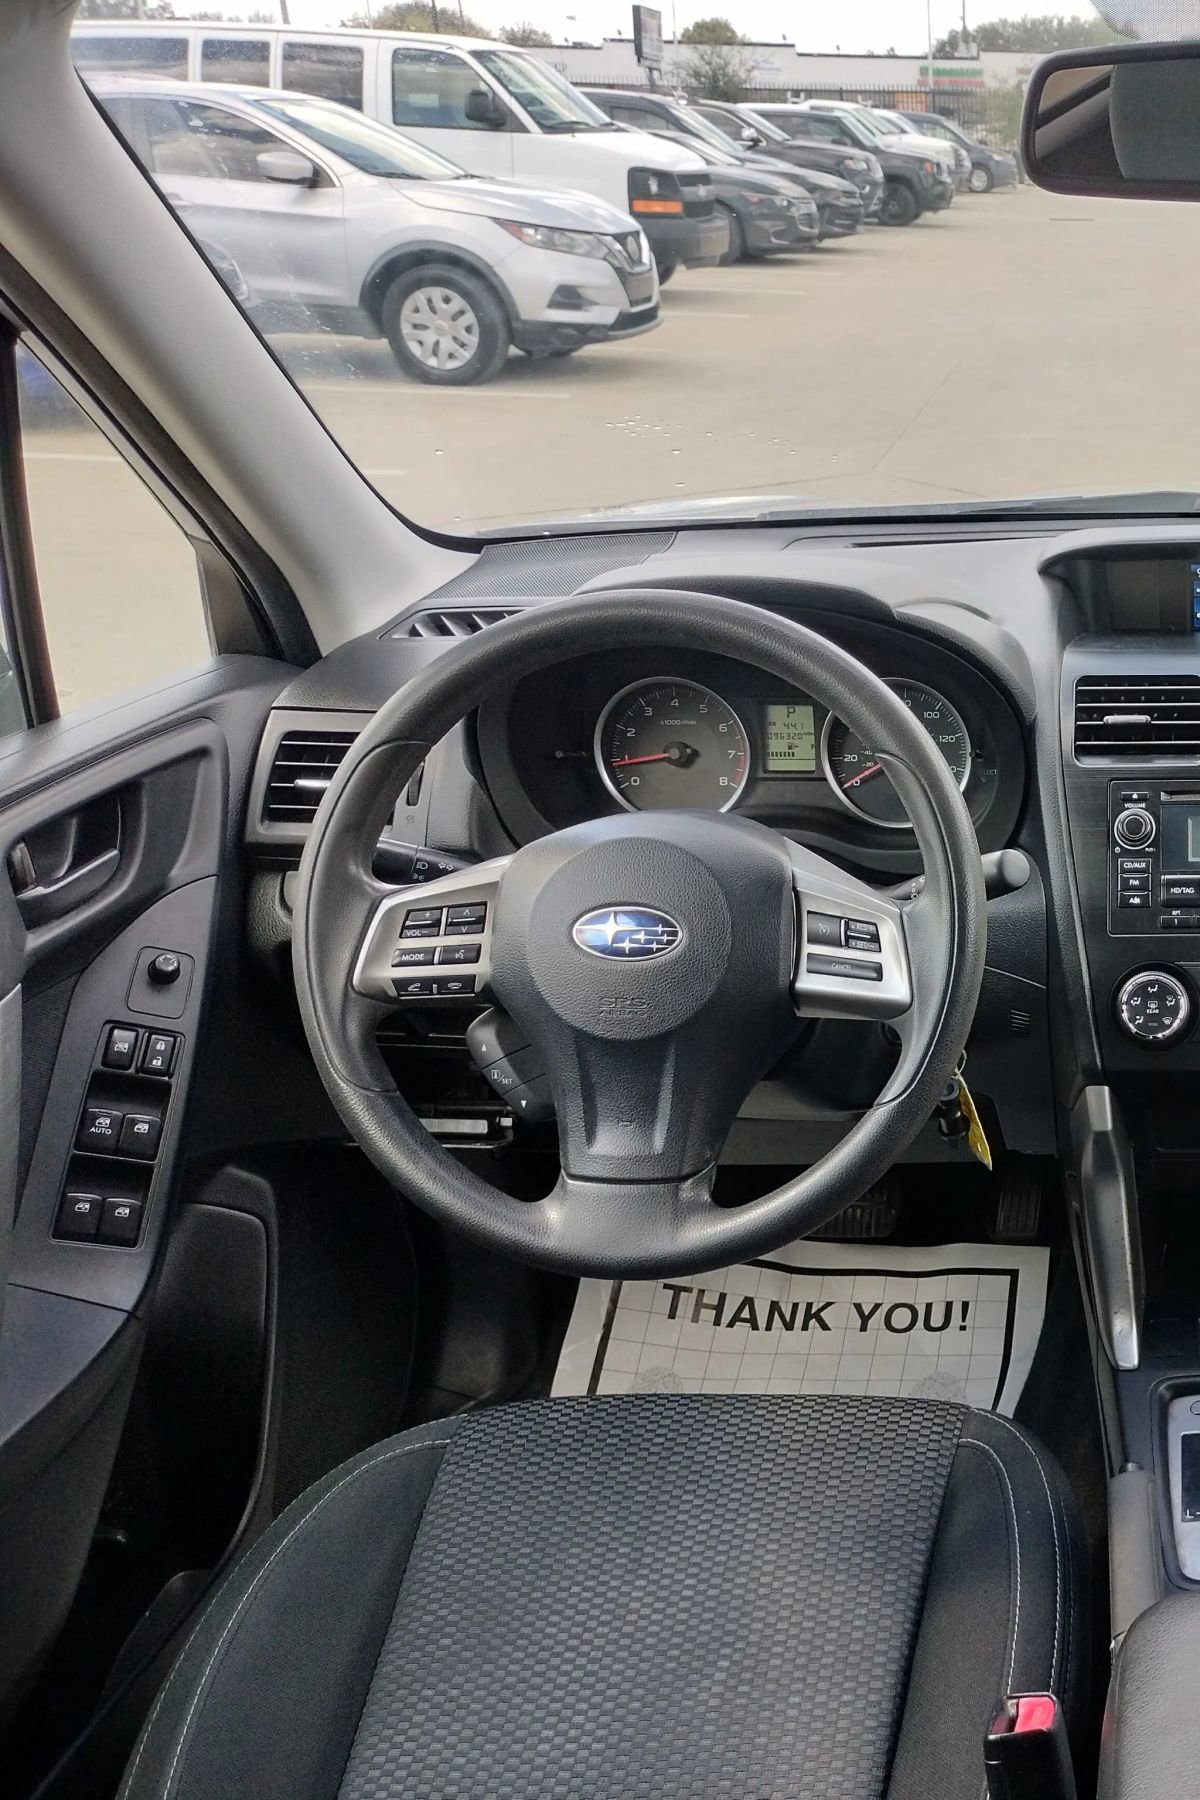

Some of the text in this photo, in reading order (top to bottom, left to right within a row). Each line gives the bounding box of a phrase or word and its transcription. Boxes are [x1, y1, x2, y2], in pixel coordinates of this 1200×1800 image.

[670, 699, 680, 707] 4
[644, 707, 653, 716] 3
[700, 704, 708, 713] 5
[787, 706, 796, 718] P
[923, 711, 940, 719] 100
[718, 724, 728, 732] 6
[626, 728, 636, 737] 2
[939, 735, 956, 743] 120
[727, 750, 736, 758] 7
[843, 754, 858, 762] 20
[631, 776, 640, 785] 0
[719, 776, 728, 785] 8
[401, 953, 425, 961] MODE
[90, 1127, 112, 1135] AUTO
[661, 1283, 970, 1333] THANK YOU!
